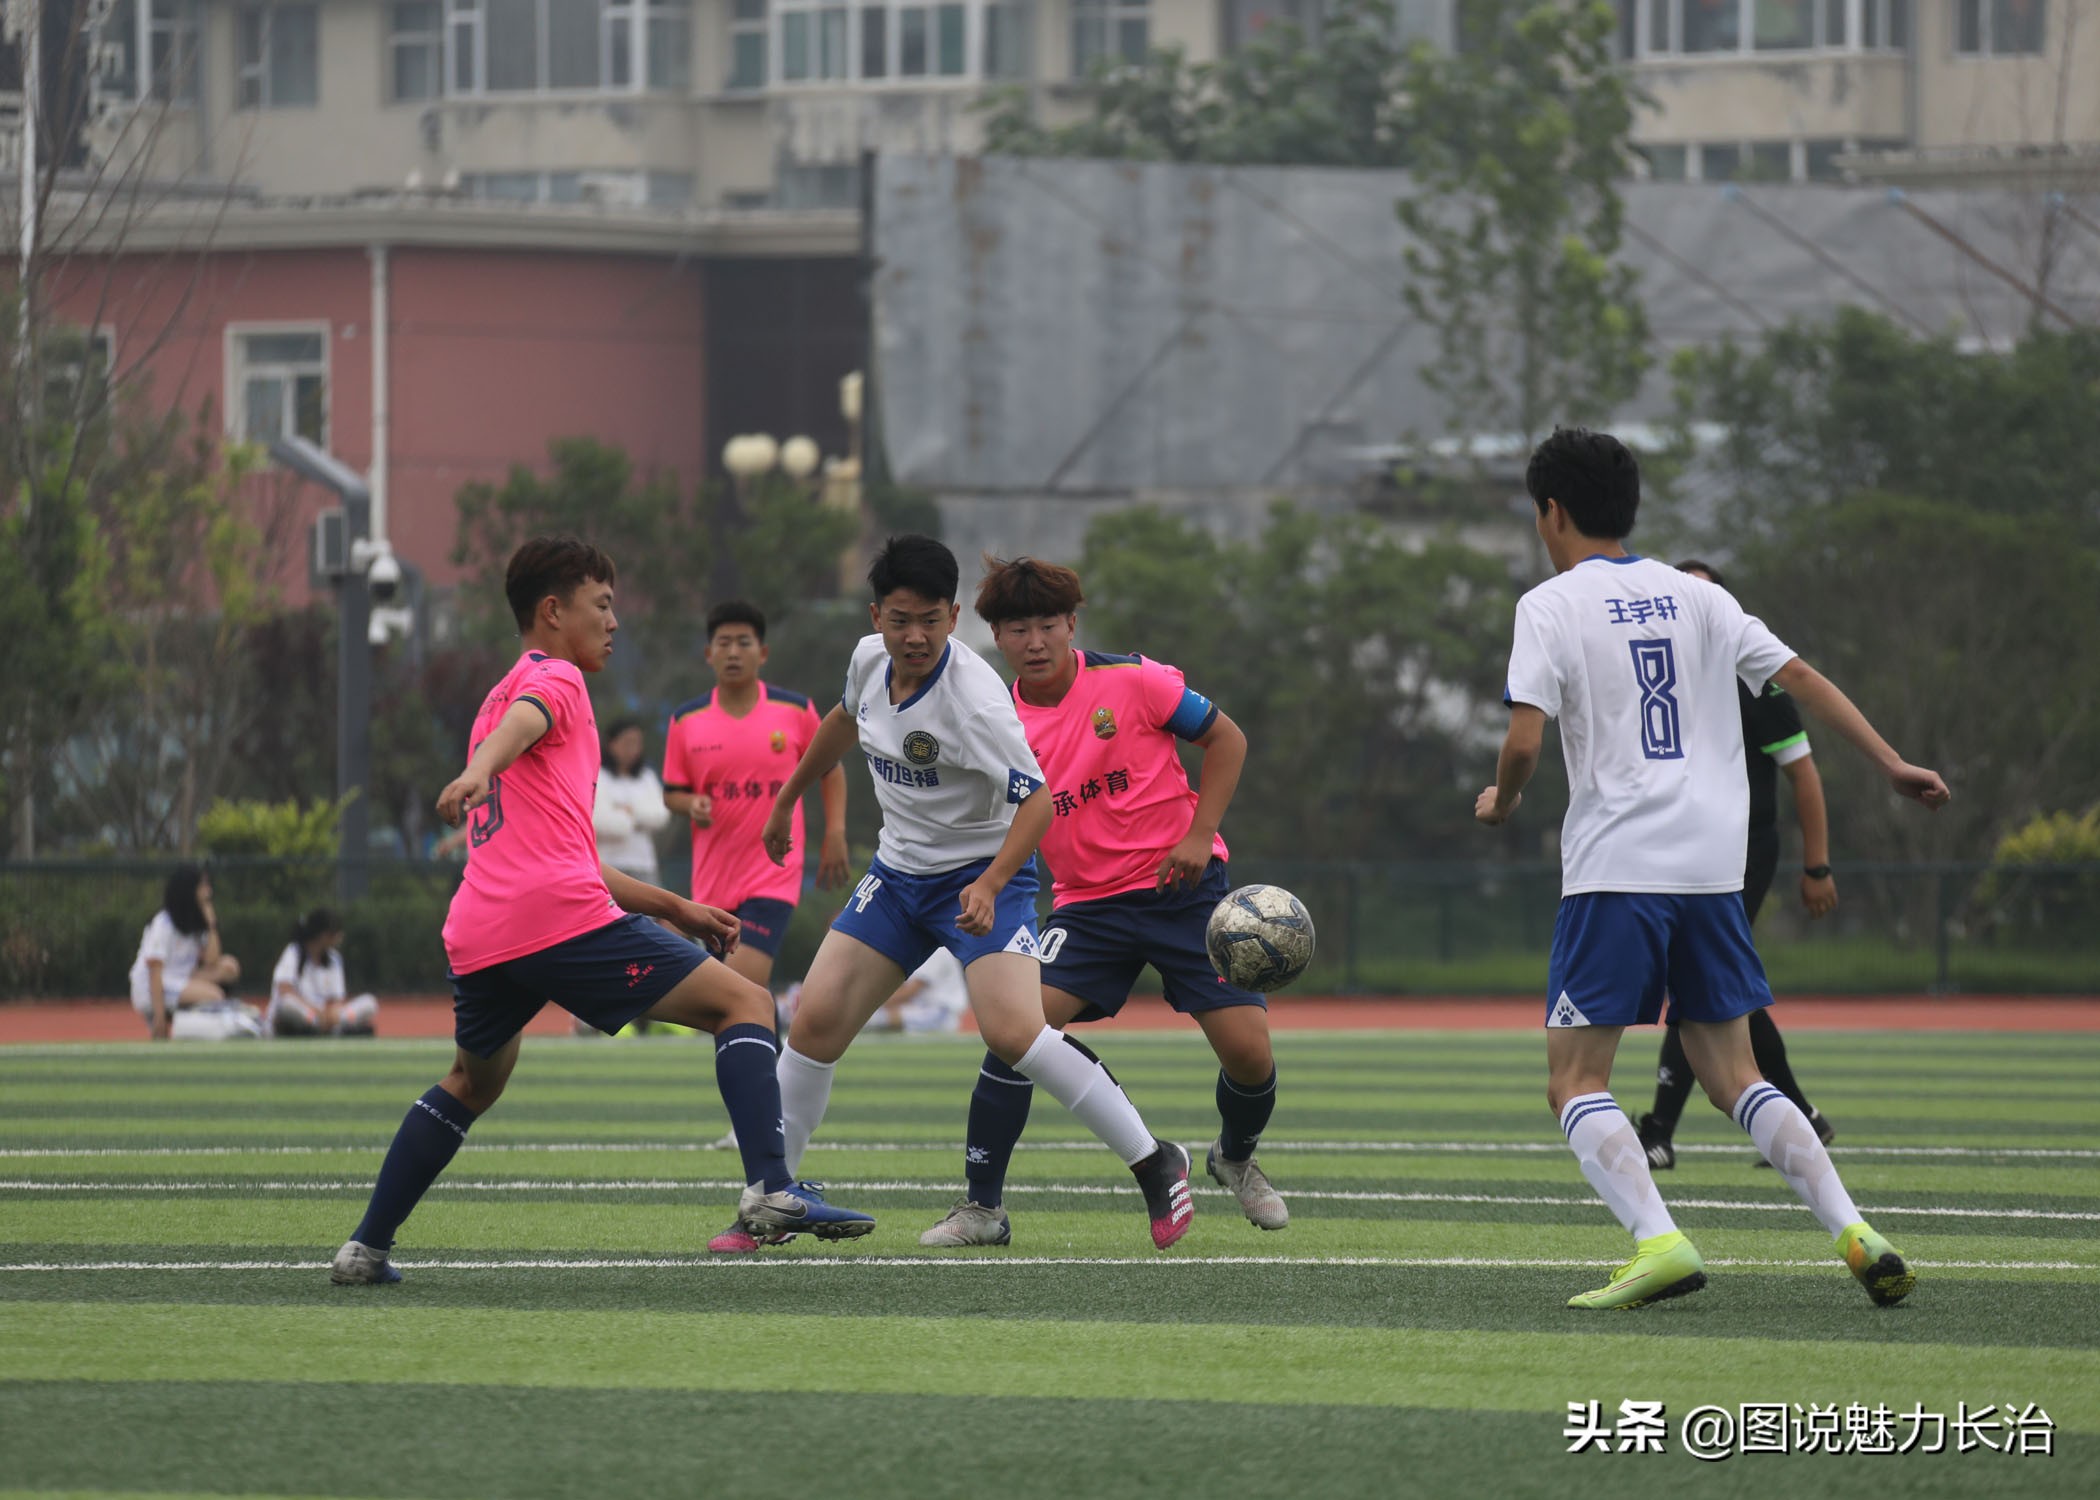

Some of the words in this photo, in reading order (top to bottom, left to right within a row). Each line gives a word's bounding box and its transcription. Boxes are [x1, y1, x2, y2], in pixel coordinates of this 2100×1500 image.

[1628, 638, 1685, 759] 8
[1053, 768, 1129, 817] 承体育
[845, 873, 882, 913] 4
[1039, 927, 1067, 963] 0
